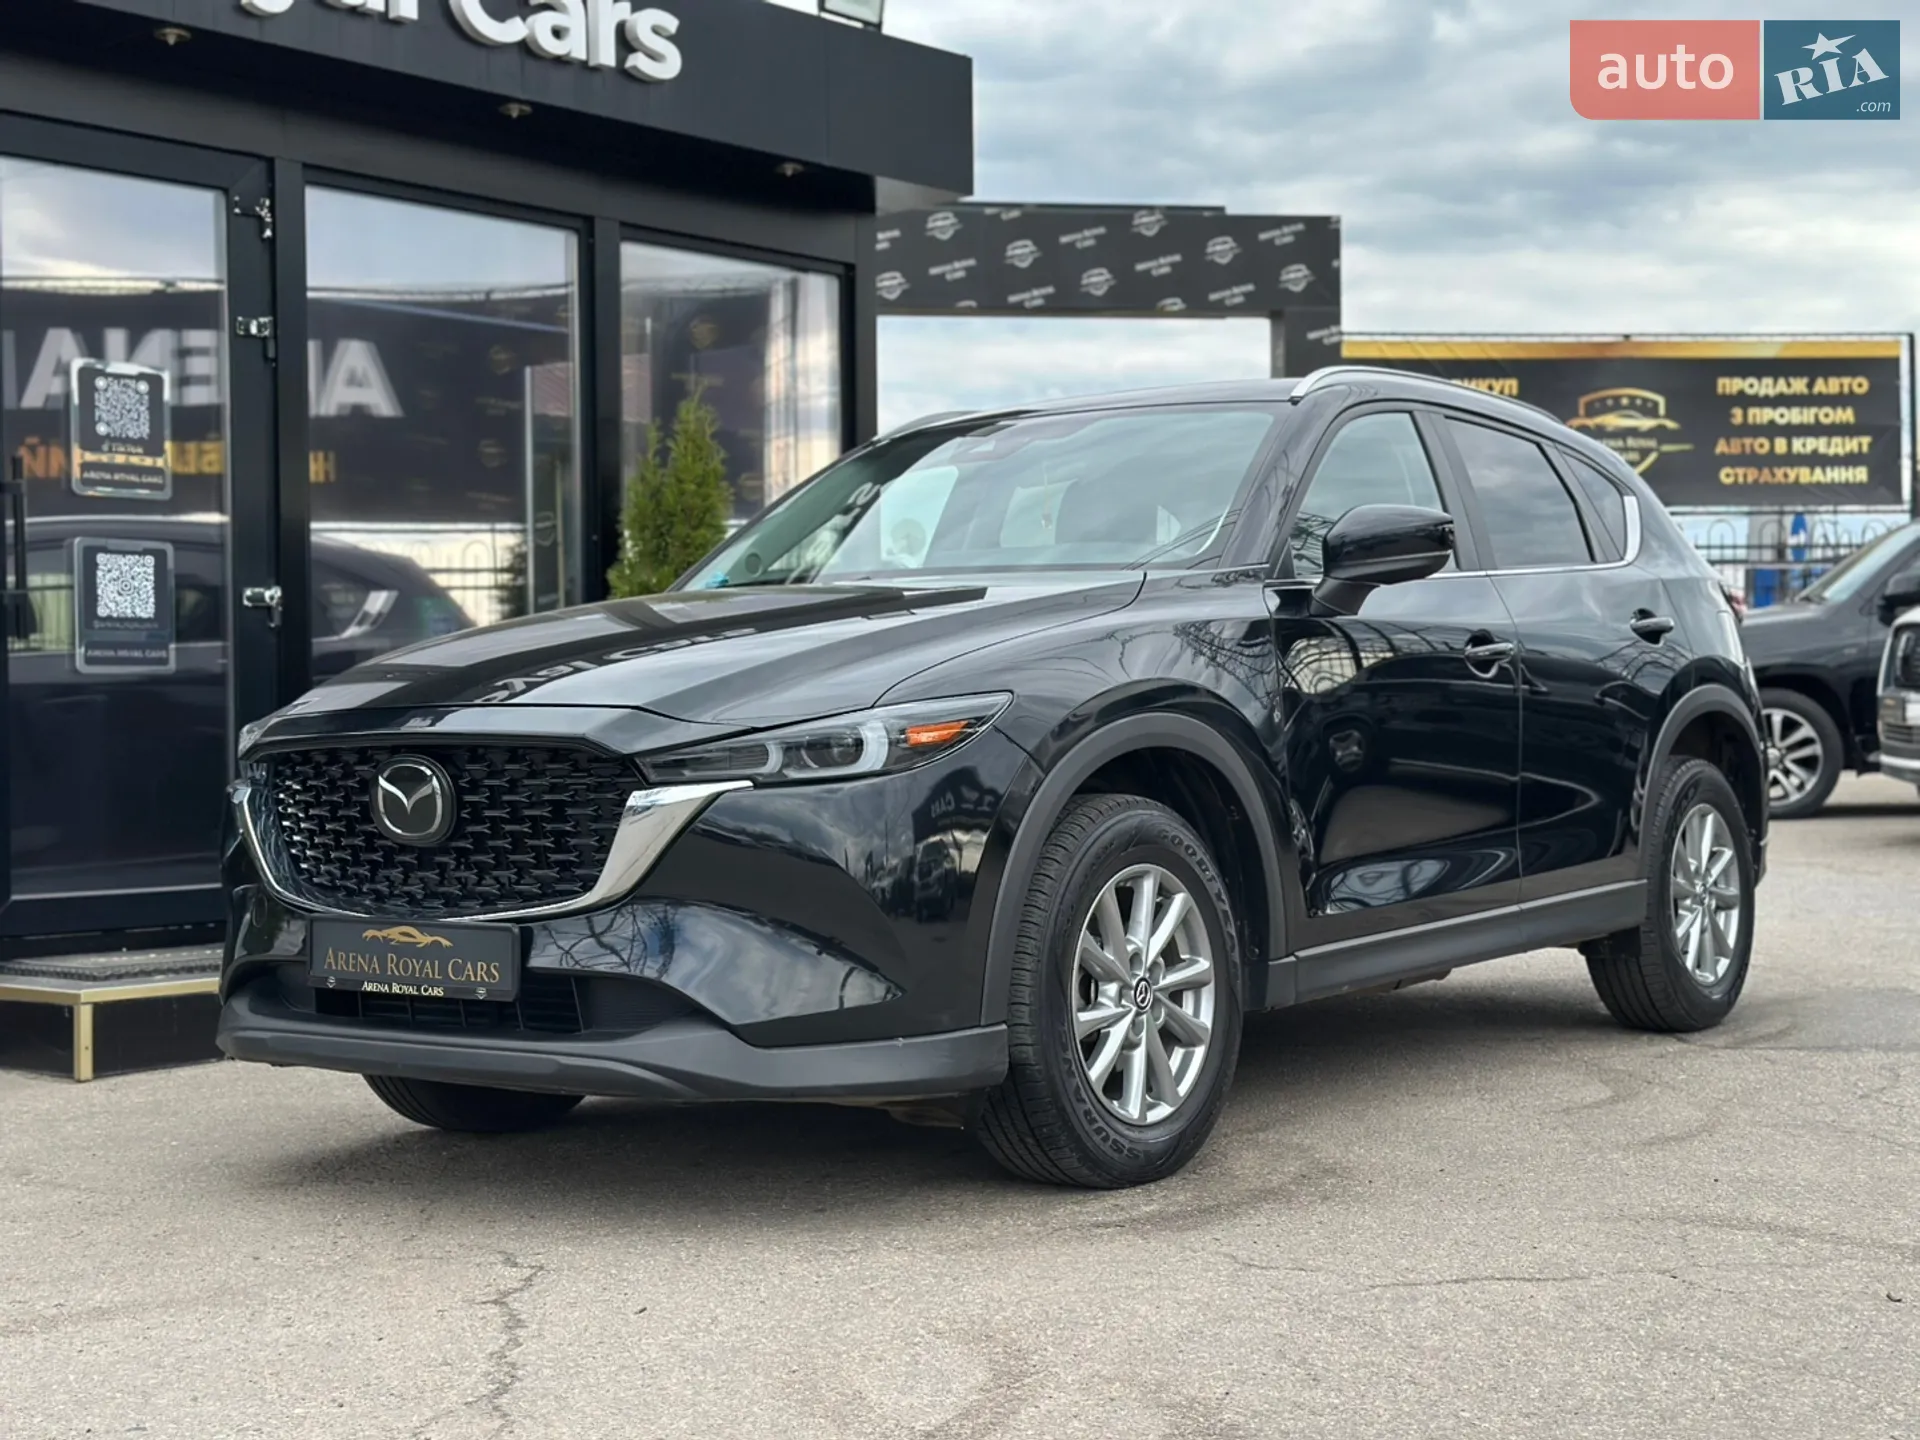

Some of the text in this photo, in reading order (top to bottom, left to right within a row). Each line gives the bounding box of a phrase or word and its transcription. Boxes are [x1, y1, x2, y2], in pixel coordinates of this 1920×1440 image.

[1451, 377, 1519, 397] ИКУП
[1716, 376, 1870, 398] ПРОДАЖ АВТО
[1747, 406, 1856, 425] ПРОБІГОМ
[1715, 435, 1873, 457] АВТО В КРЕДИТ
[1719, 465, 1869, 485] СТРАХУВАННЯ
[324, 947, 500, 983] ARENA ROYAL CARS
[361, 981, 444, 996] ARENA ROYAL CARS
